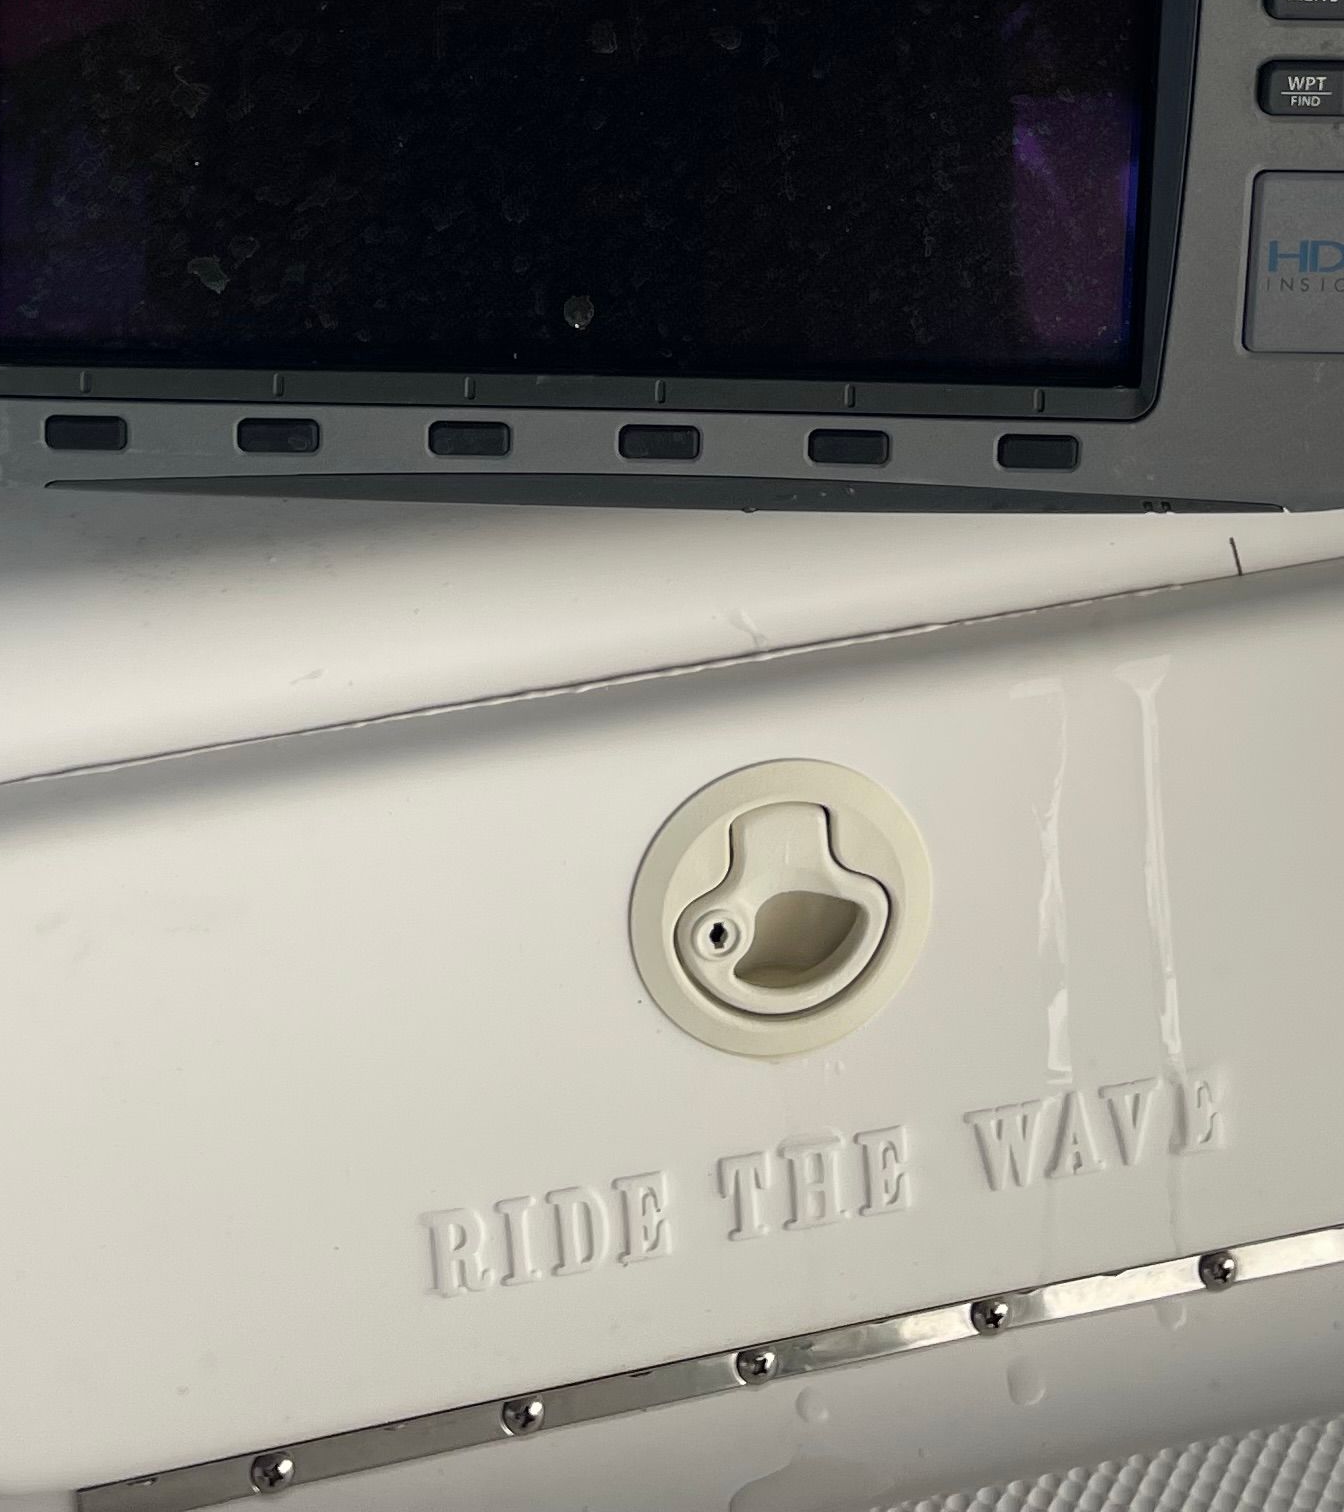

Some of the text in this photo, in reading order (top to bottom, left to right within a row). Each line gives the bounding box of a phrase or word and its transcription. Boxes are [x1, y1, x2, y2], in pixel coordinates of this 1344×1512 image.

[1287, 76, 1327, 91] WPT
[1290, 96, 1321, 107] FIND
[422, 1070, 1232, 1299] RIDE THE WAVE
